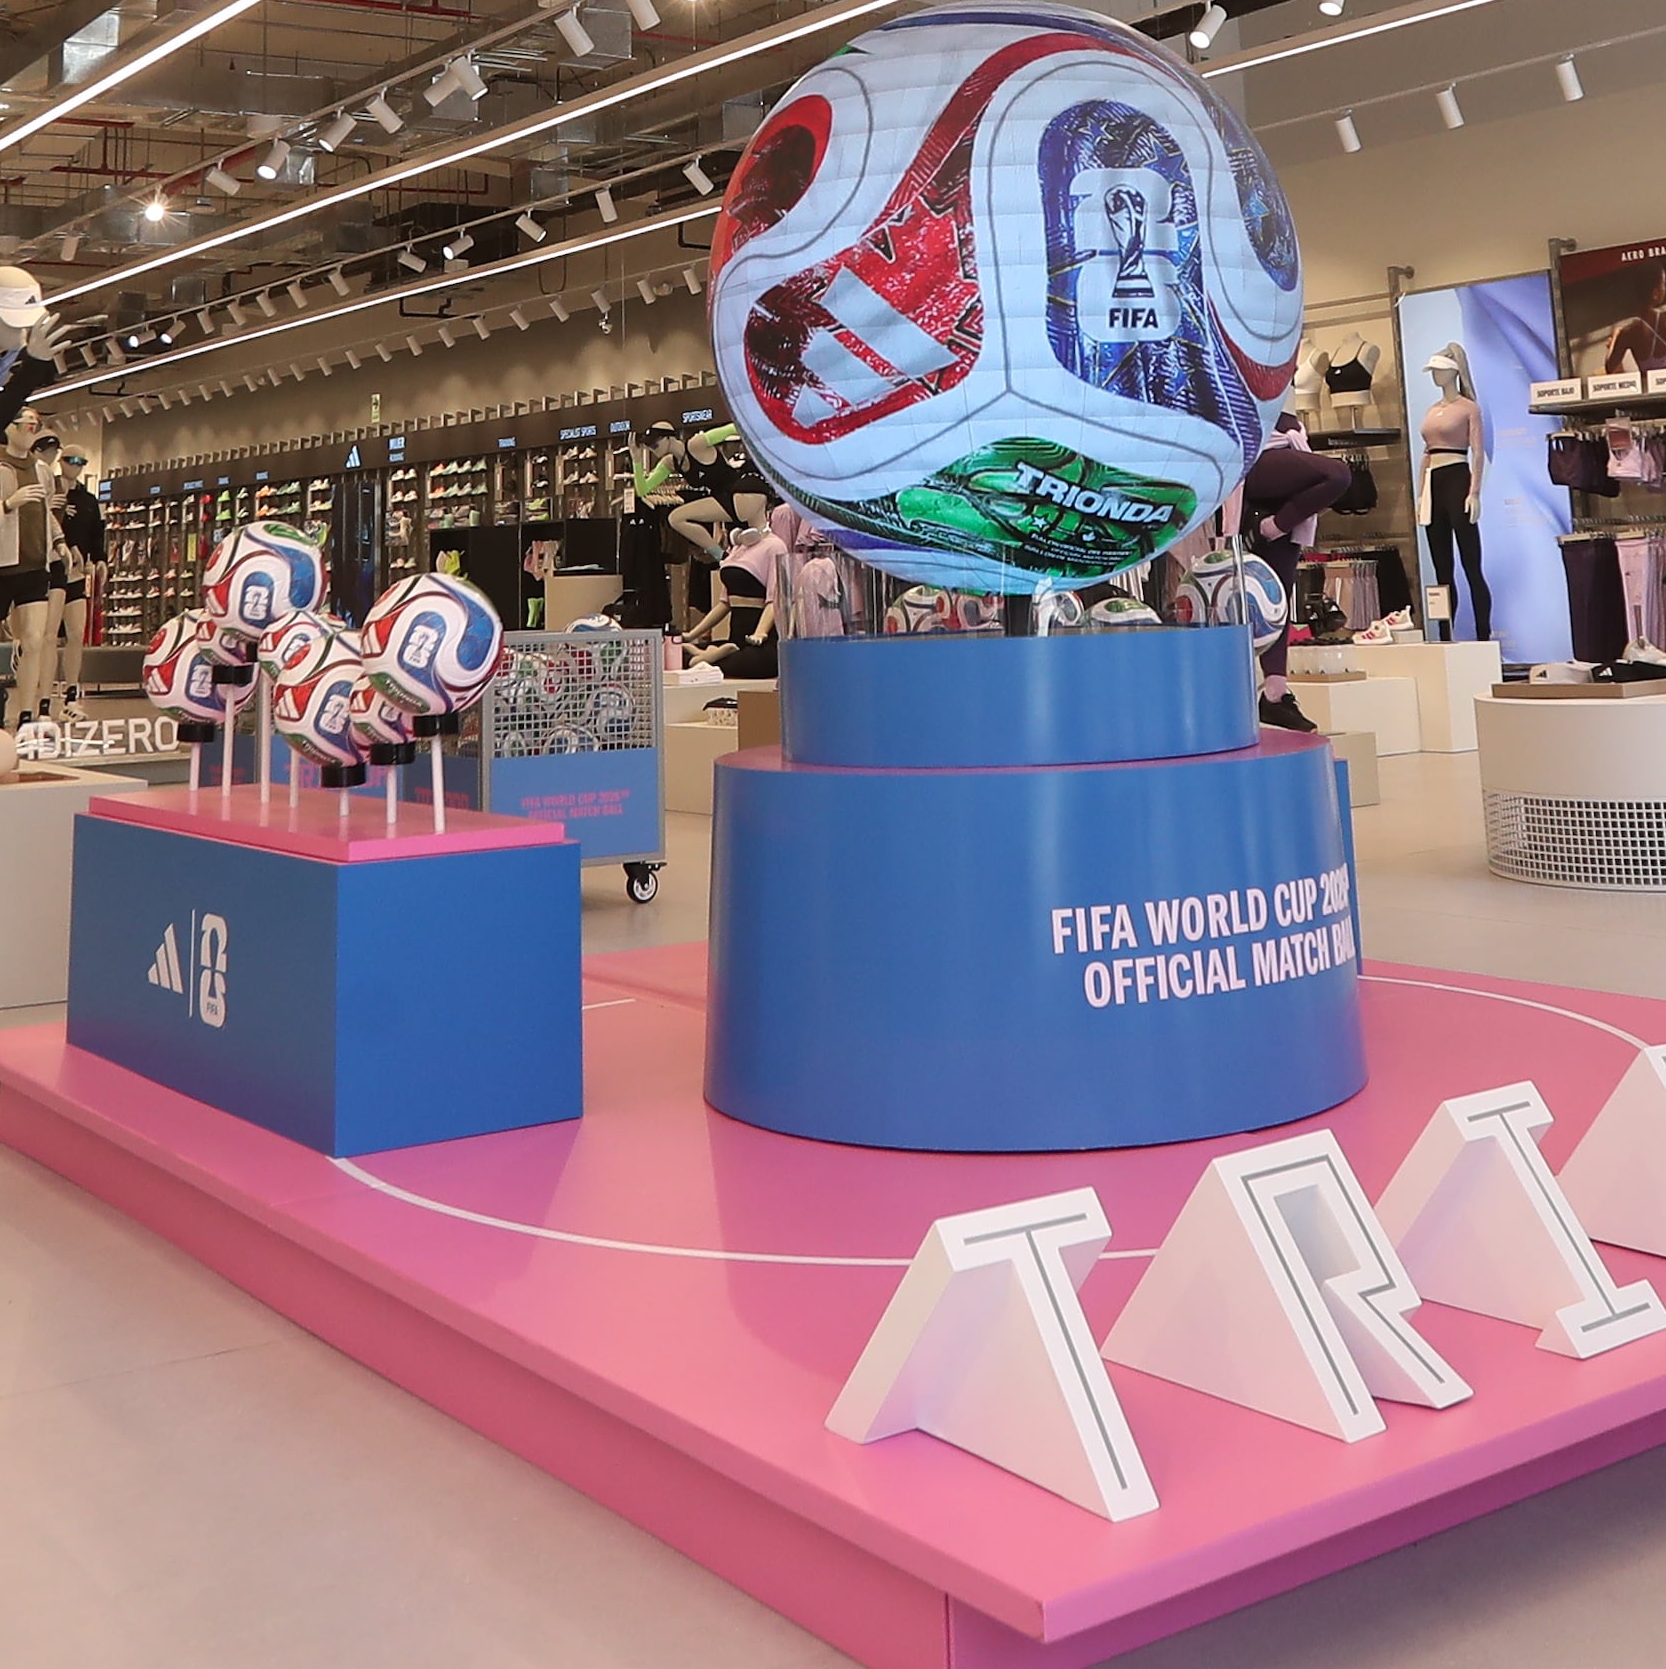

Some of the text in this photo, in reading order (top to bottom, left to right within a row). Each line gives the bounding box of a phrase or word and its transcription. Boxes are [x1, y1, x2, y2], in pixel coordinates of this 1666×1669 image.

[1109, 308, 1158, 328] FIFA
[1017, 462, 1174, 524] TRIONDA
[16, 716, 180, 760] ADIZERO
[1051, 904, 1138, 954] FIFA
[1145, 888, 1267, 946] WORLD
[1274, 876, 1317, 928] CUP
[1084, 945, 1246, 1008] OFFICIAL
[1252, 929, 1330, 986] MATCH
